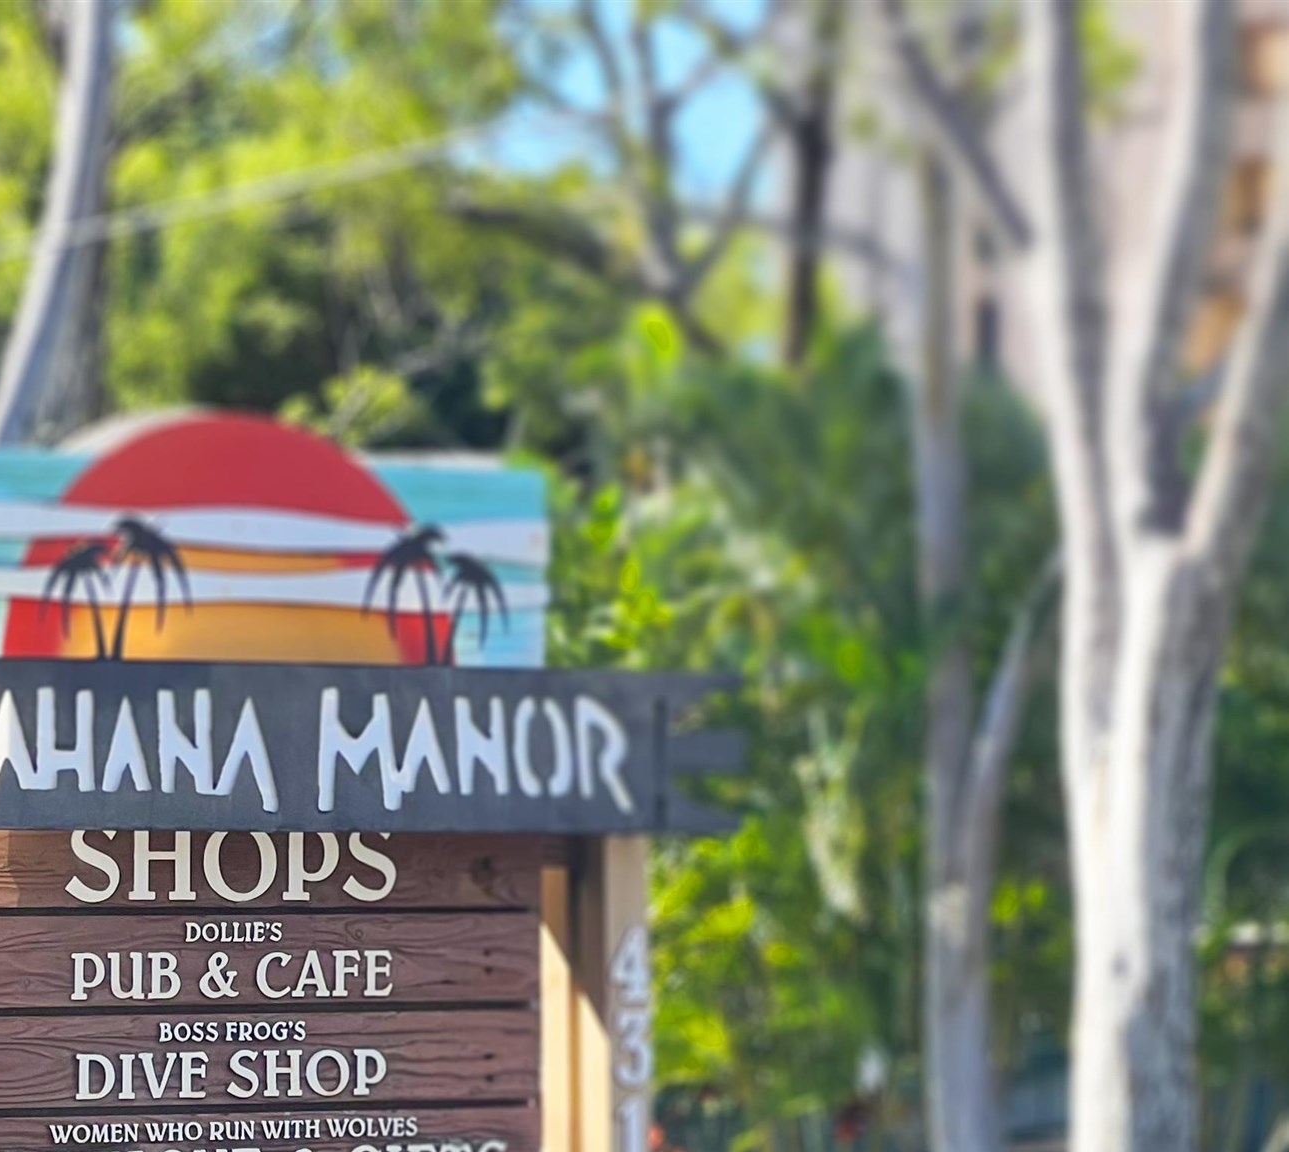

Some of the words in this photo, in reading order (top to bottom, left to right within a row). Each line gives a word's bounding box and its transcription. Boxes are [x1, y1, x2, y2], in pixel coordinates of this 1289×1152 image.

[318, 686, 633, 812] MANOR
[65, 831, 397, 903] SHOPS
[185, 922, 282, 944] DOLLIE'S
[71, 951, 182, 1001] PUB
[198, 954, 239, 998] &
[256, 948, 393, 998] CAFE
[159, 1022, 219, 1043] BOSS
[225, 1020, 306, 1041] FROG'S
[75, 1051, 208, 1101] DIVE
[227, 1048, 387, 1098] SHOP
[49, 1123, 142, 1144] WOMEN
[145, 1122, 204, 1142] WHO
[209, 1120, 257, 1141] RUN
[261, 1119, 321, 1140] WITH
[326, 1117, 418, 1138] WOLVES
